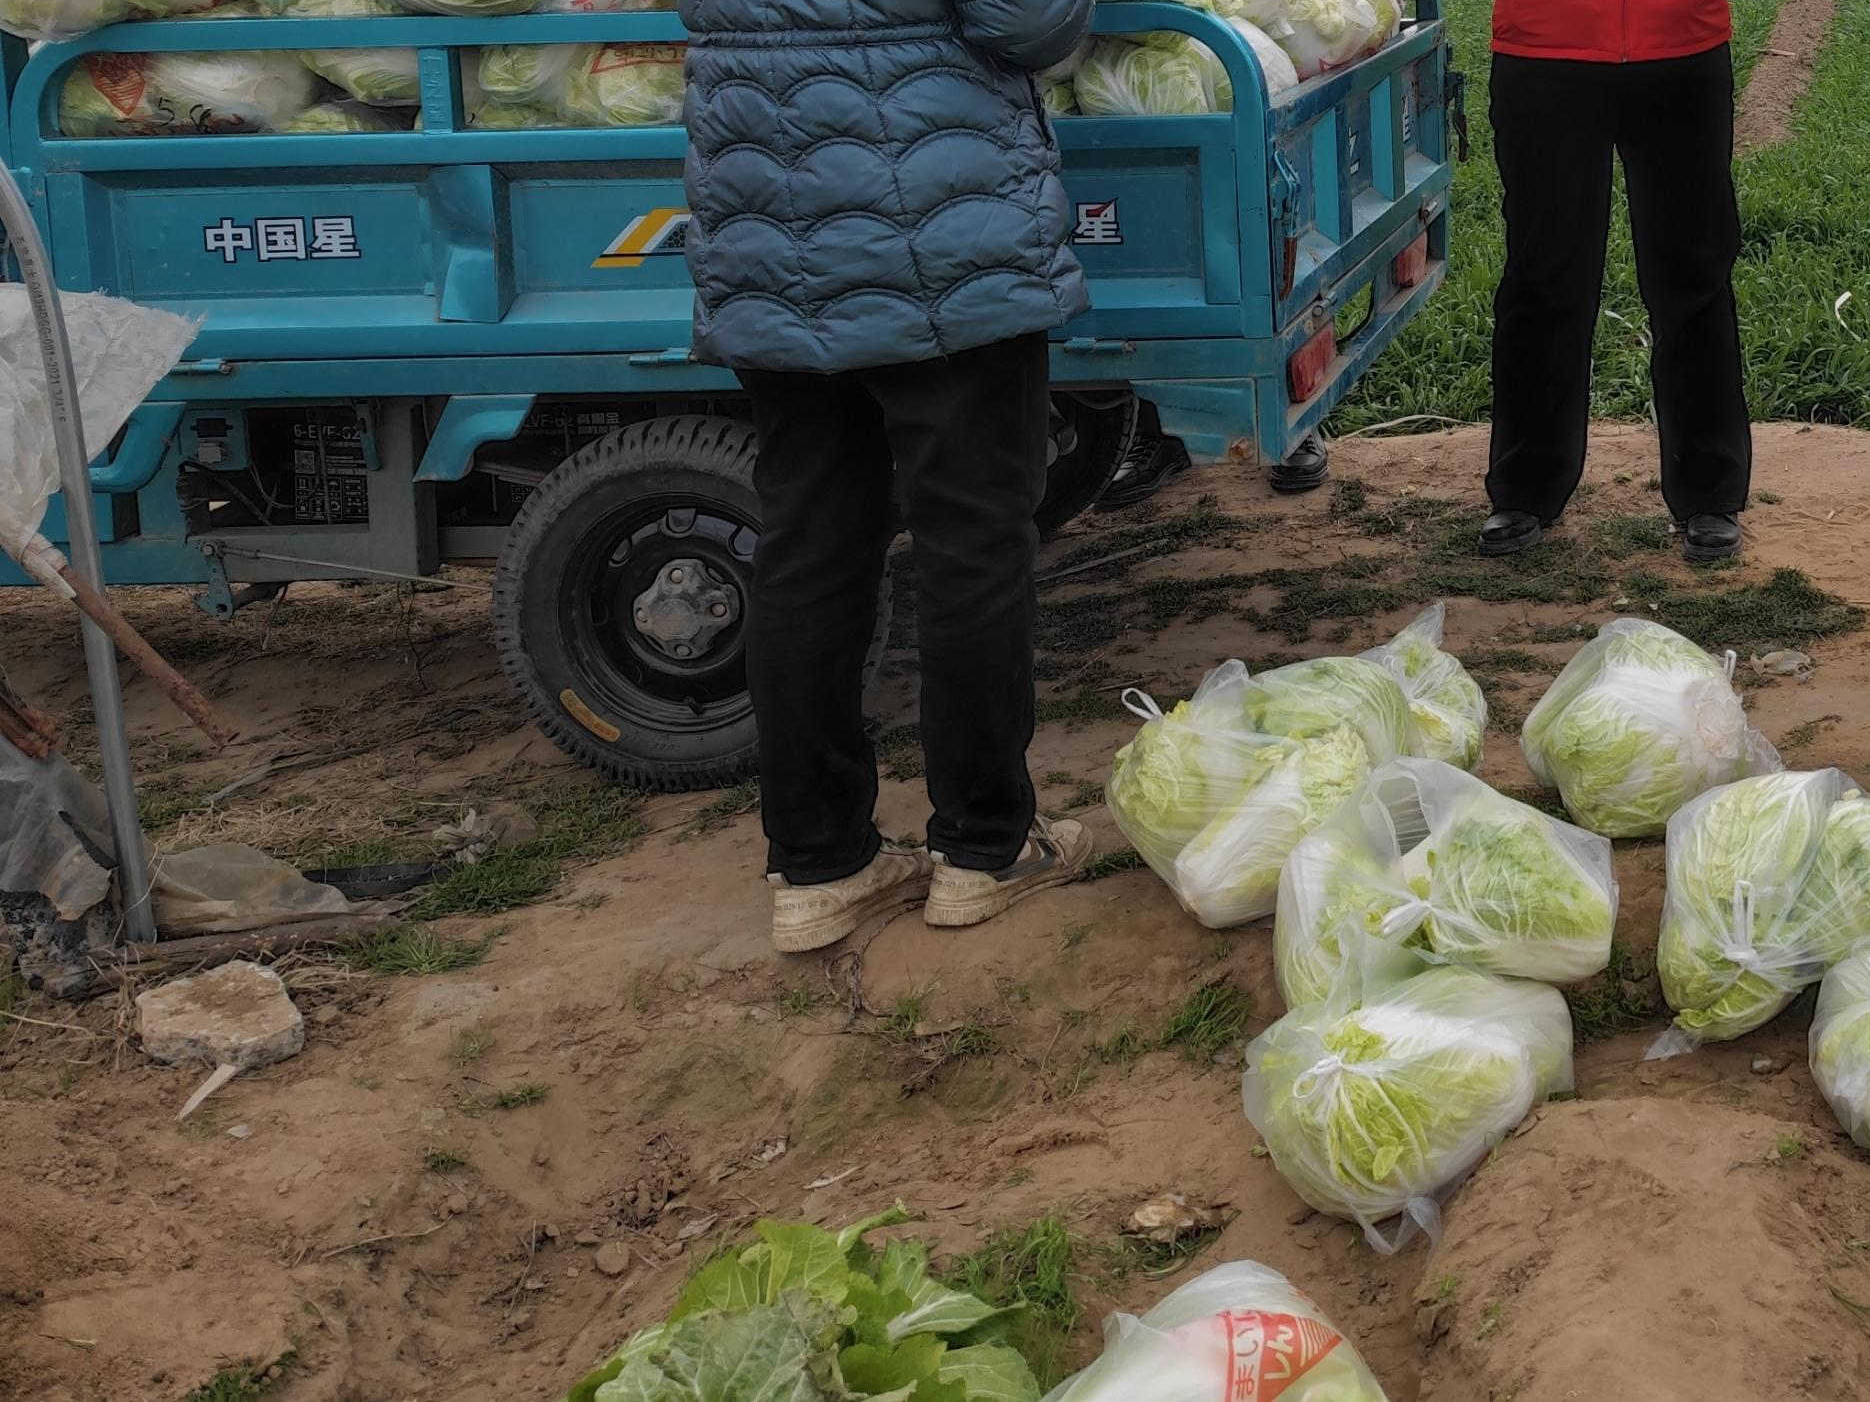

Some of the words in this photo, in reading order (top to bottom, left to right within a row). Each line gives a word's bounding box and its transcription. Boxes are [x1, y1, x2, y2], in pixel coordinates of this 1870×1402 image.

[203, 216, 362, 264] 中国星
[1068, 197, 1124, 246] 星
